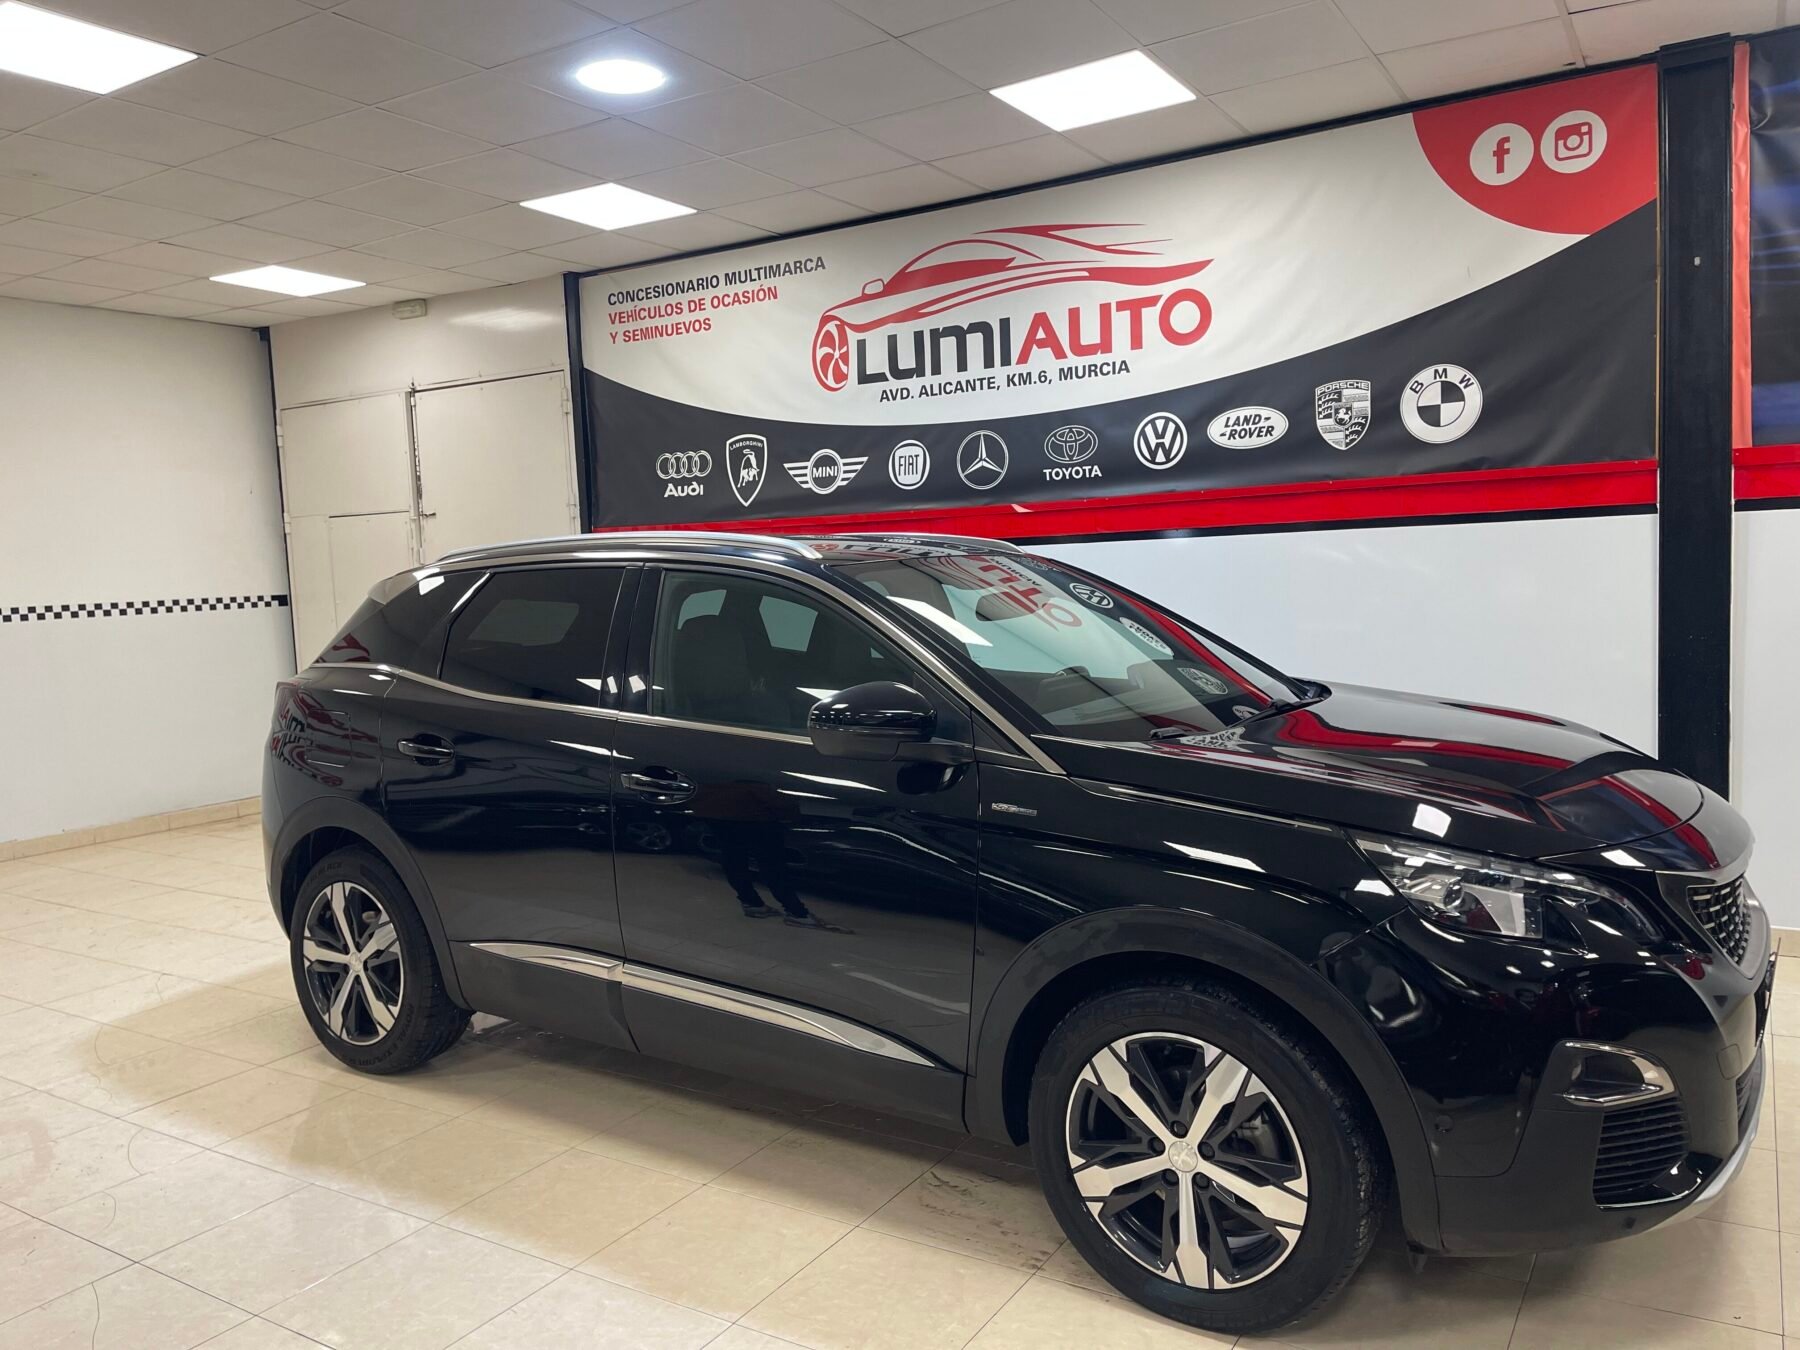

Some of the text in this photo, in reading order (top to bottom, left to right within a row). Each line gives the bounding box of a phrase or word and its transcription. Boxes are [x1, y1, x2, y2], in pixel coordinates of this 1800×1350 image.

[608, 256, 826, 306] CONCESIONARIO MULTIMARCA
[608, 284, 779, 326] VEHÍCULOS DE OCASIÓN
[609, 318, 712, 345] Y SEMINUEVOS
[879, 385, 915, 403] AVD.
[918, 376, 1001, 399] ALICANTE,
[1058, 360, 1131, 382] MURCIA
[1317, 381, 1370, 396] PORSCHE
[1409, 367, 1475, 395] BMW
[729, 440, 764, 451] LAMBORGHINI
[812, 465, 838, 478] MINI
[898, 454, 920, 477] FIAT
[1043, 465, 1102, 481] TOYOTA
[663, 481, 704, 498] Audi
